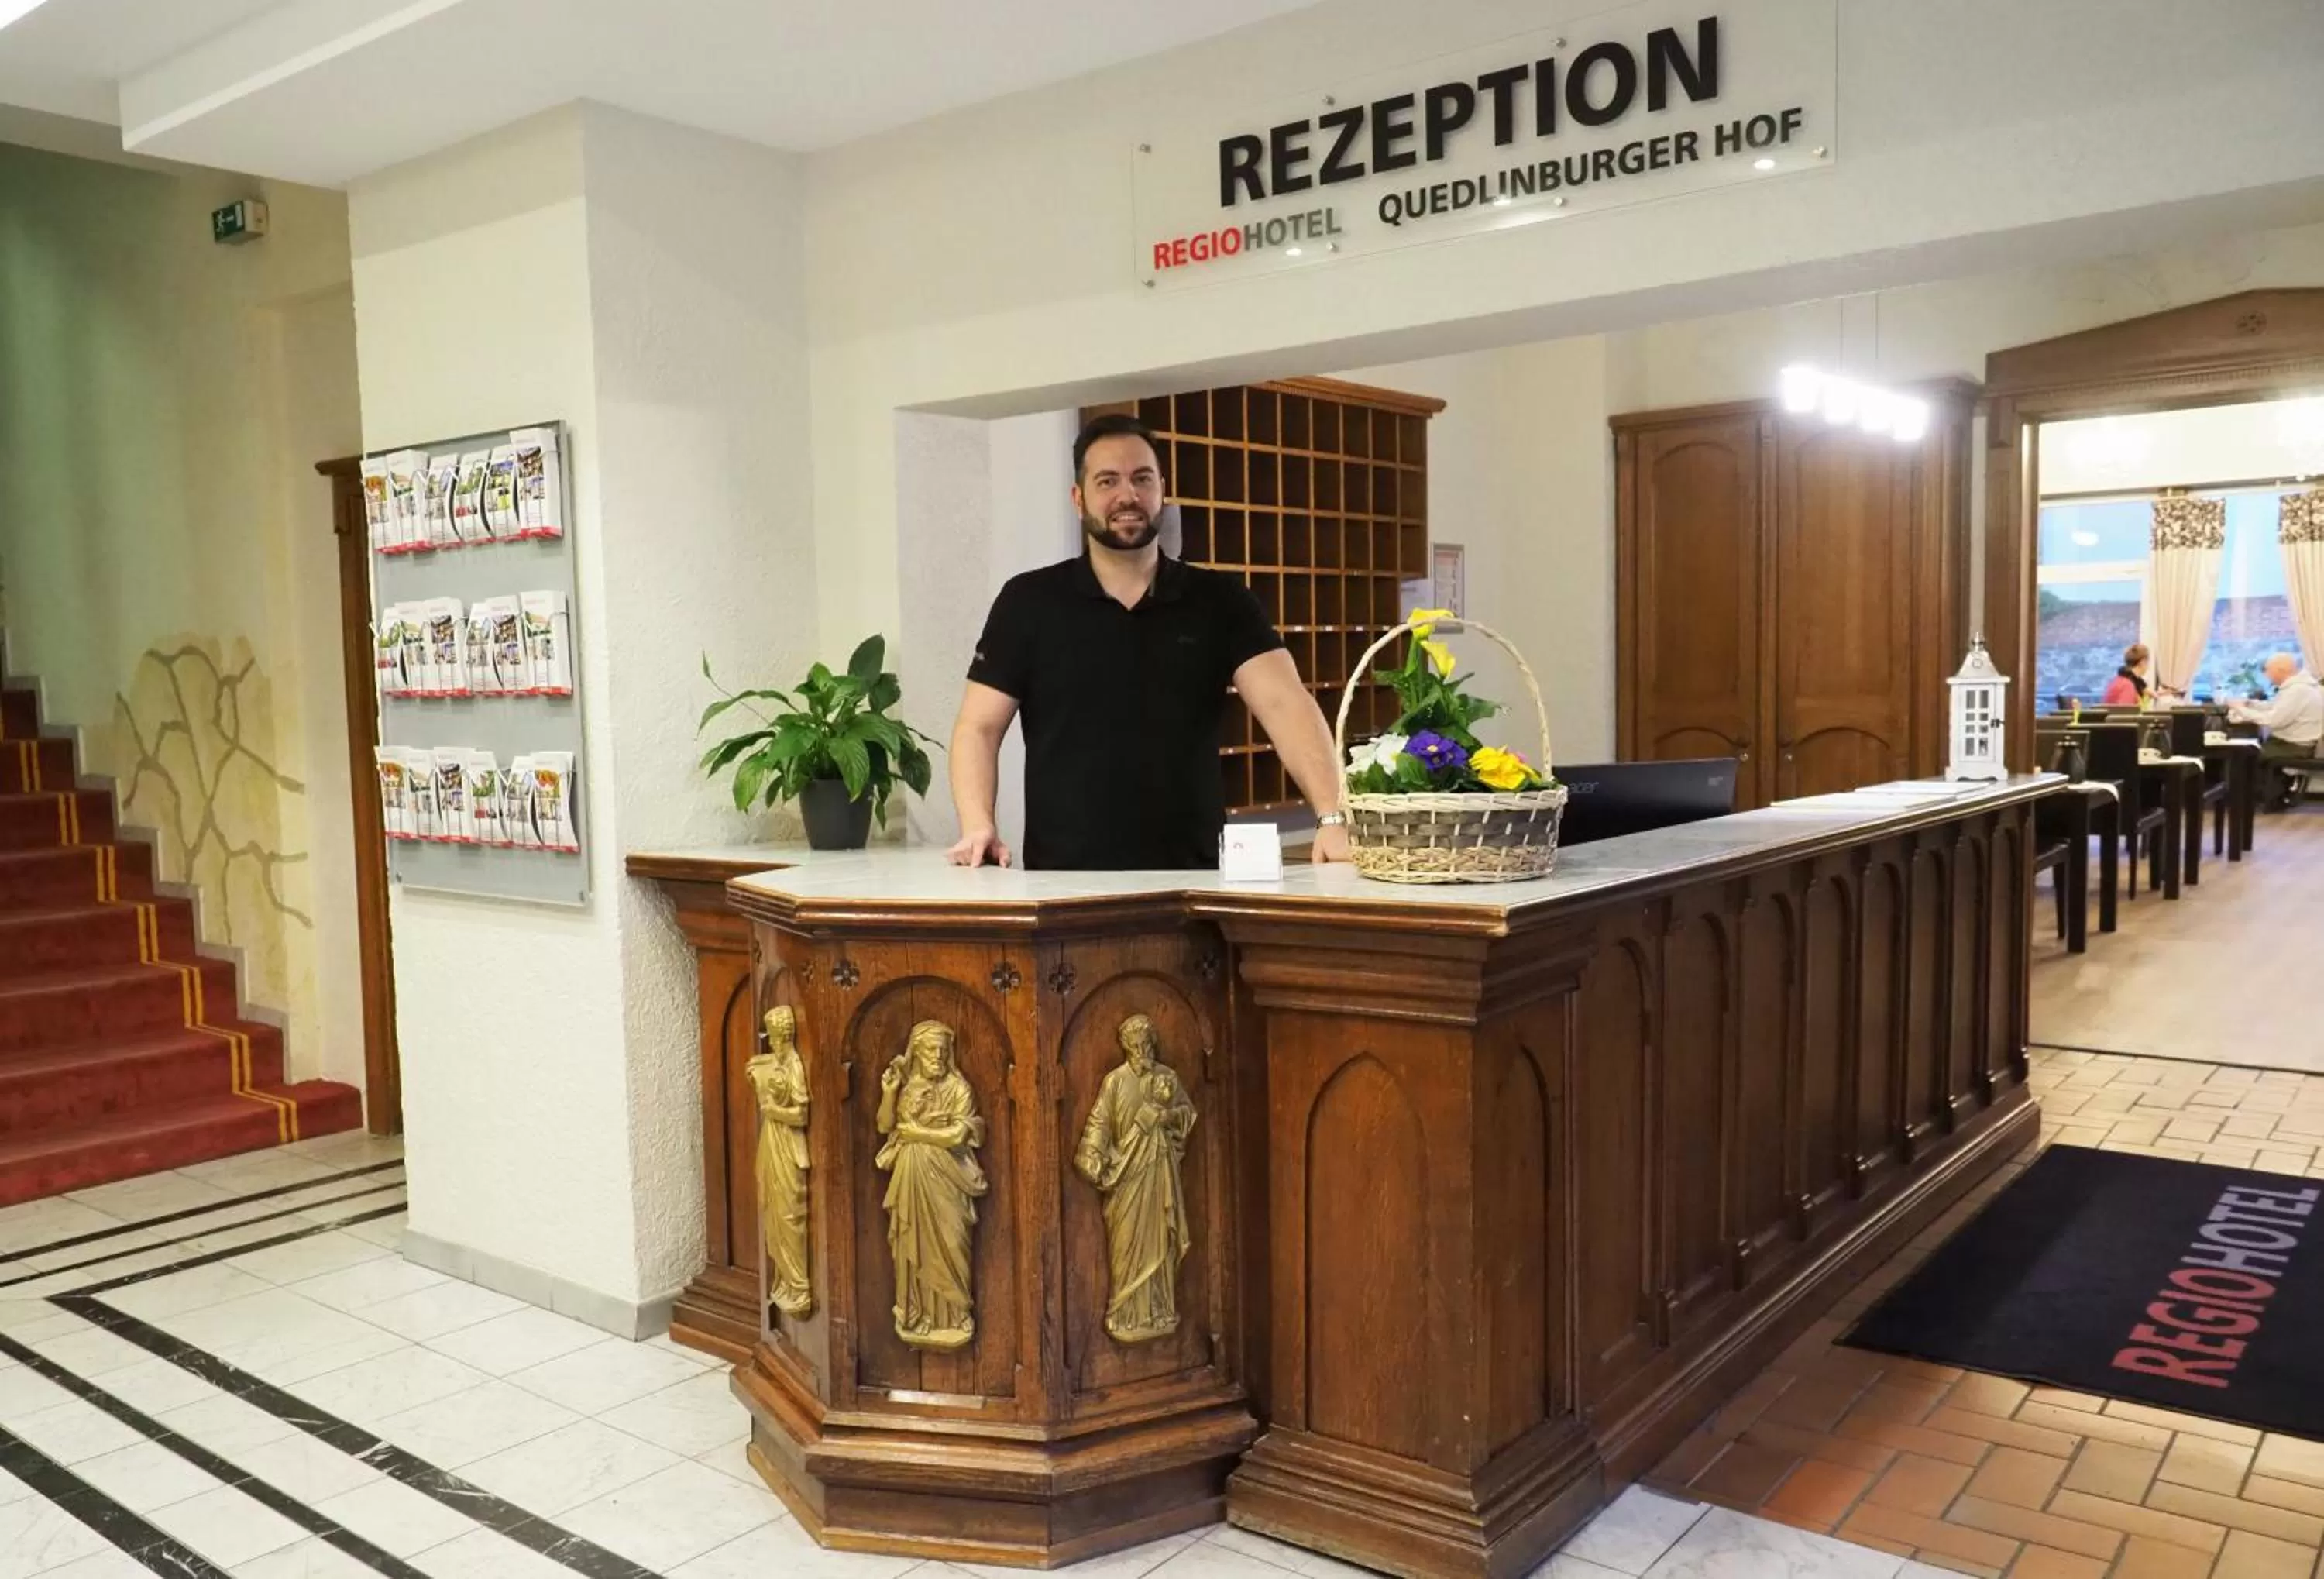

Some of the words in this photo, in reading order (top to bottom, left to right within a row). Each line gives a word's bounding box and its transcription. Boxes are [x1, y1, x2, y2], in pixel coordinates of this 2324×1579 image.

[1153, 207, 1343, 270] REGIOHOTEL
[1377, 130, 1700, 227] QUEDLINBURGER
[1714, 106, 1803, 157] HOF
[1219, 15, 1720, 208] REZEPTION
[1569, 781, 1600, 795] acer
[2112, 1185, 2321, 1388] REGIOHOTEL
